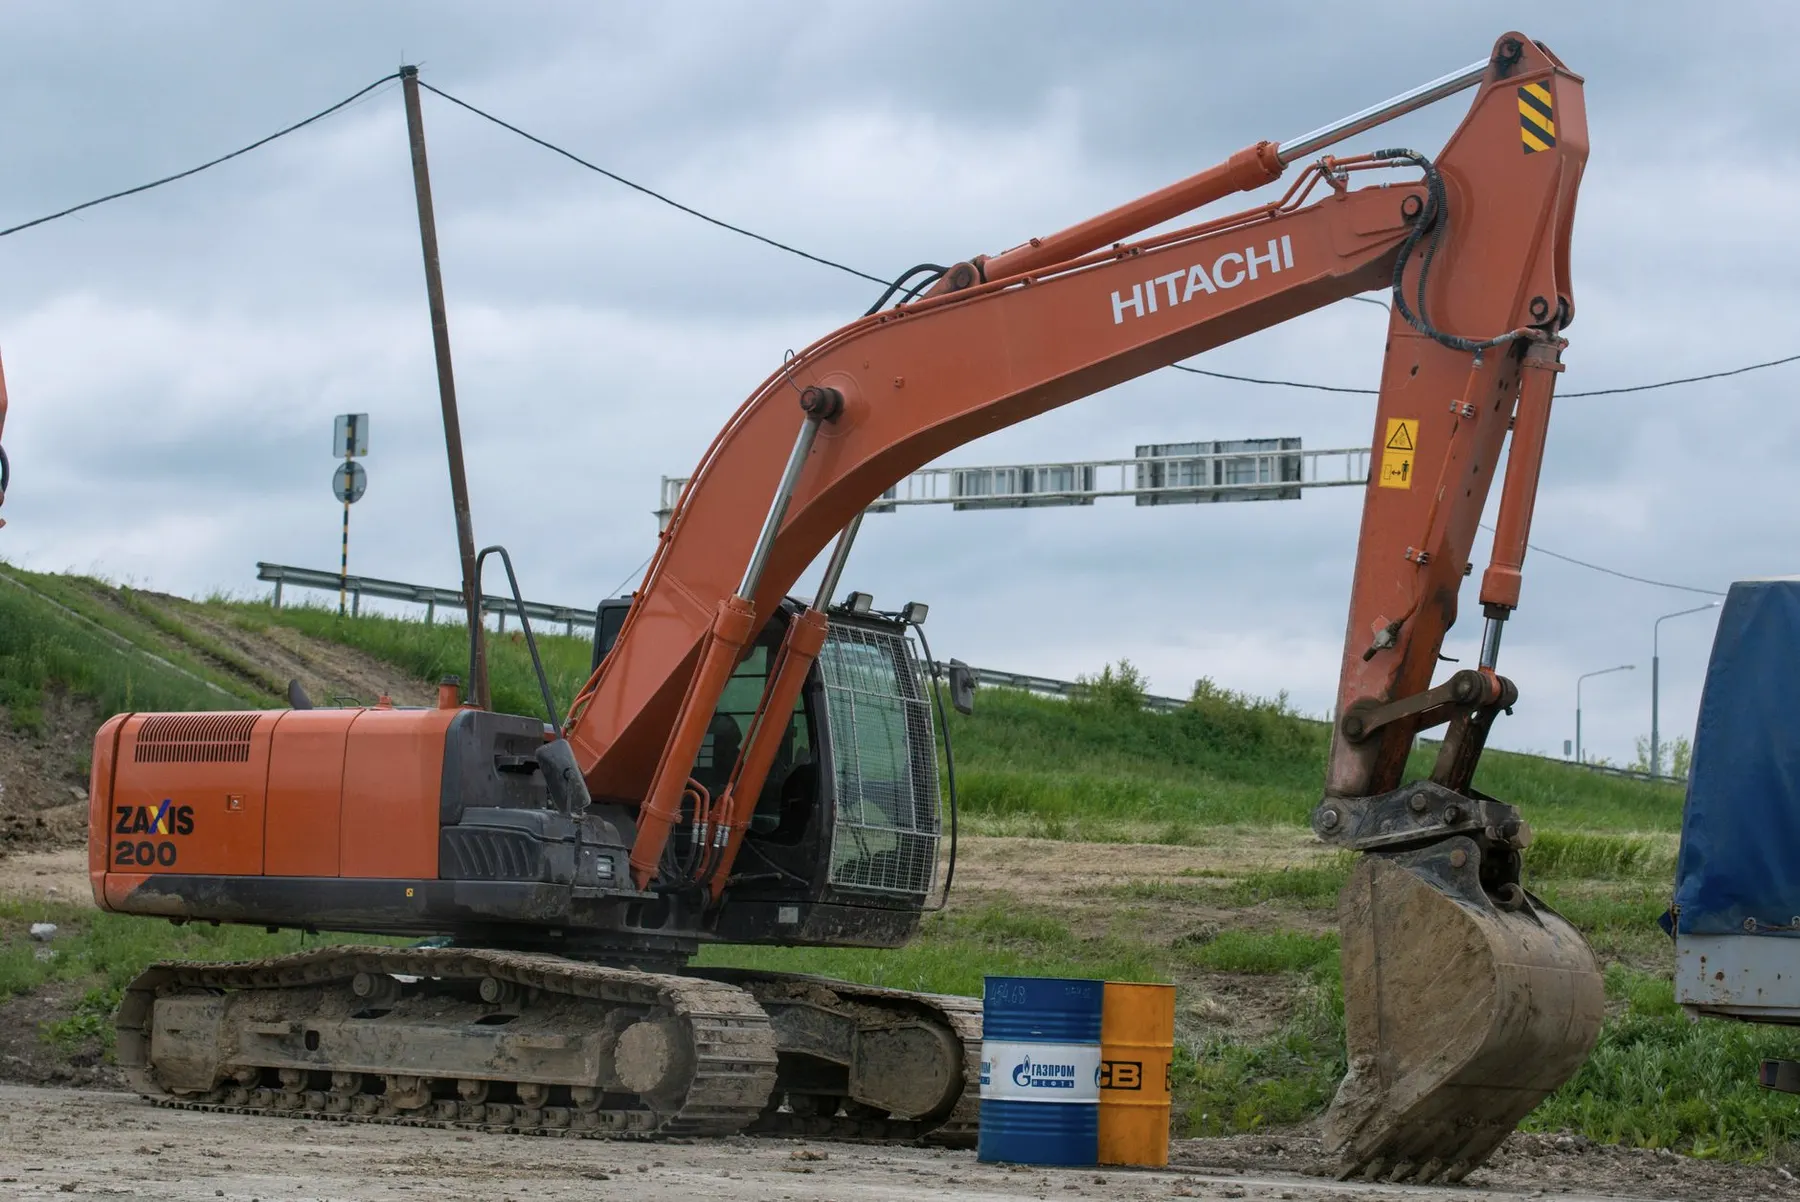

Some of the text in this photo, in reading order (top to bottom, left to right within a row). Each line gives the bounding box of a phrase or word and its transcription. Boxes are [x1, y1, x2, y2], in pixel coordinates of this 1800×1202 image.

[1110, 234, 1295, 325] HITACHI
[115, 799, 194, 836] ZAXIS
[114, 840, 177, 867] 200
[1031, 1063, 1075, 1077] ГАЗПРОМ
